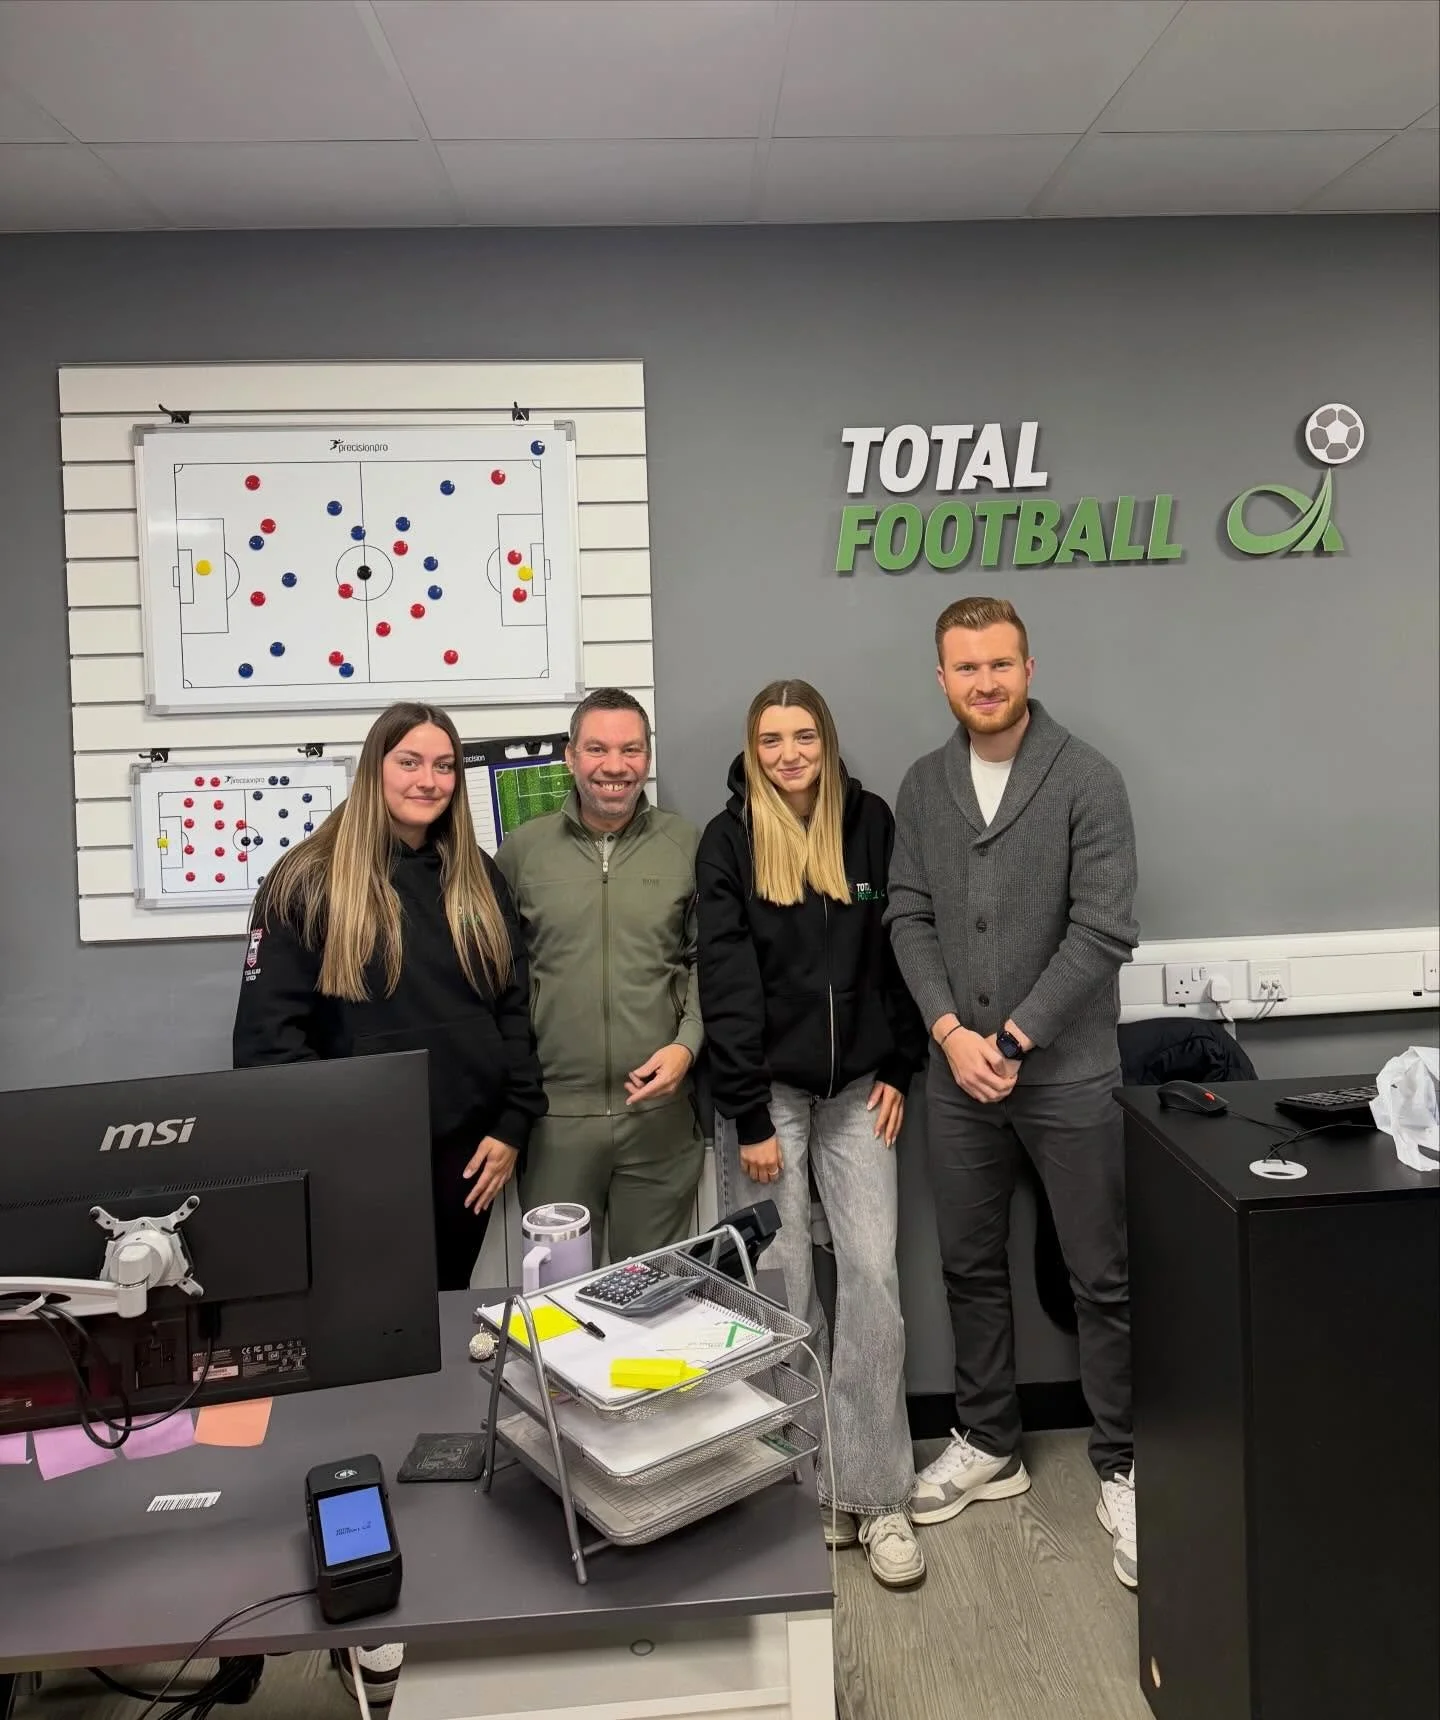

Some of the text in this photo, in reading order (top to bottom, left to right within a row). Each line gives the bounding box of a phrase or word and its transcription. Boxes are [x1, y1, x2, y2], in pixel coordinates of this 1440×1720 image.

[338, 442, 389, 453] precisionpro
[841, 421, 1048, 494] TOTAL
[835, 494, 1182, 572] FOOTBALL
[462, 753, 486, 763] recision
[99, 1116, 197, 1152] msi
